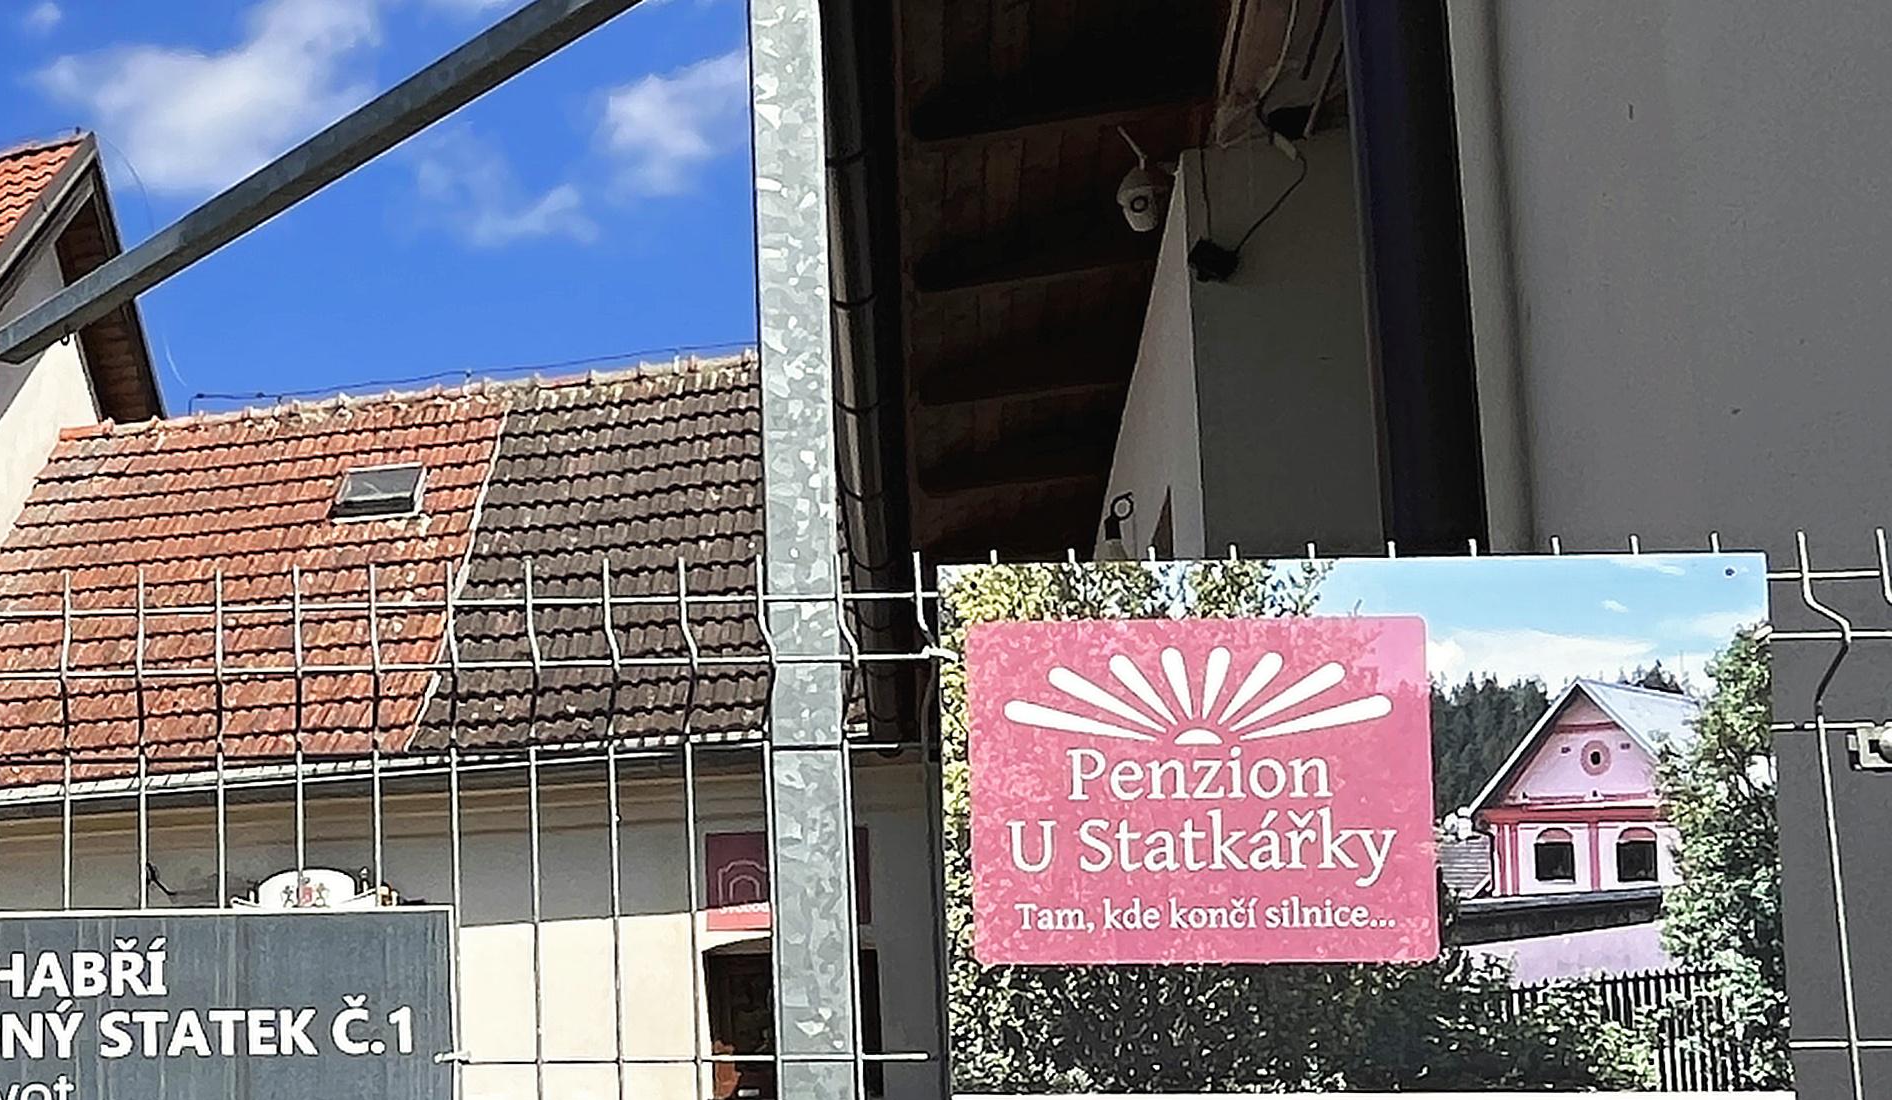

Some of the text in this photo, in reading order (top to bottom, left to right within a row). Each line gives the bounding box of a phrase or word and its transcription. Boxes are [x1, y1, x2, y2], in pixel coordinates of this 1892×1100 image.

[1066, 746, 1333, 801] Penzion
[1007, 806, 1397, 887] U Statkářky
[1015, 896, 1396, 933] Tam, kde končí silnice...
[100, 1007, 317, 1058] STATEK
[331, 995, 413, 1055] Č.1
